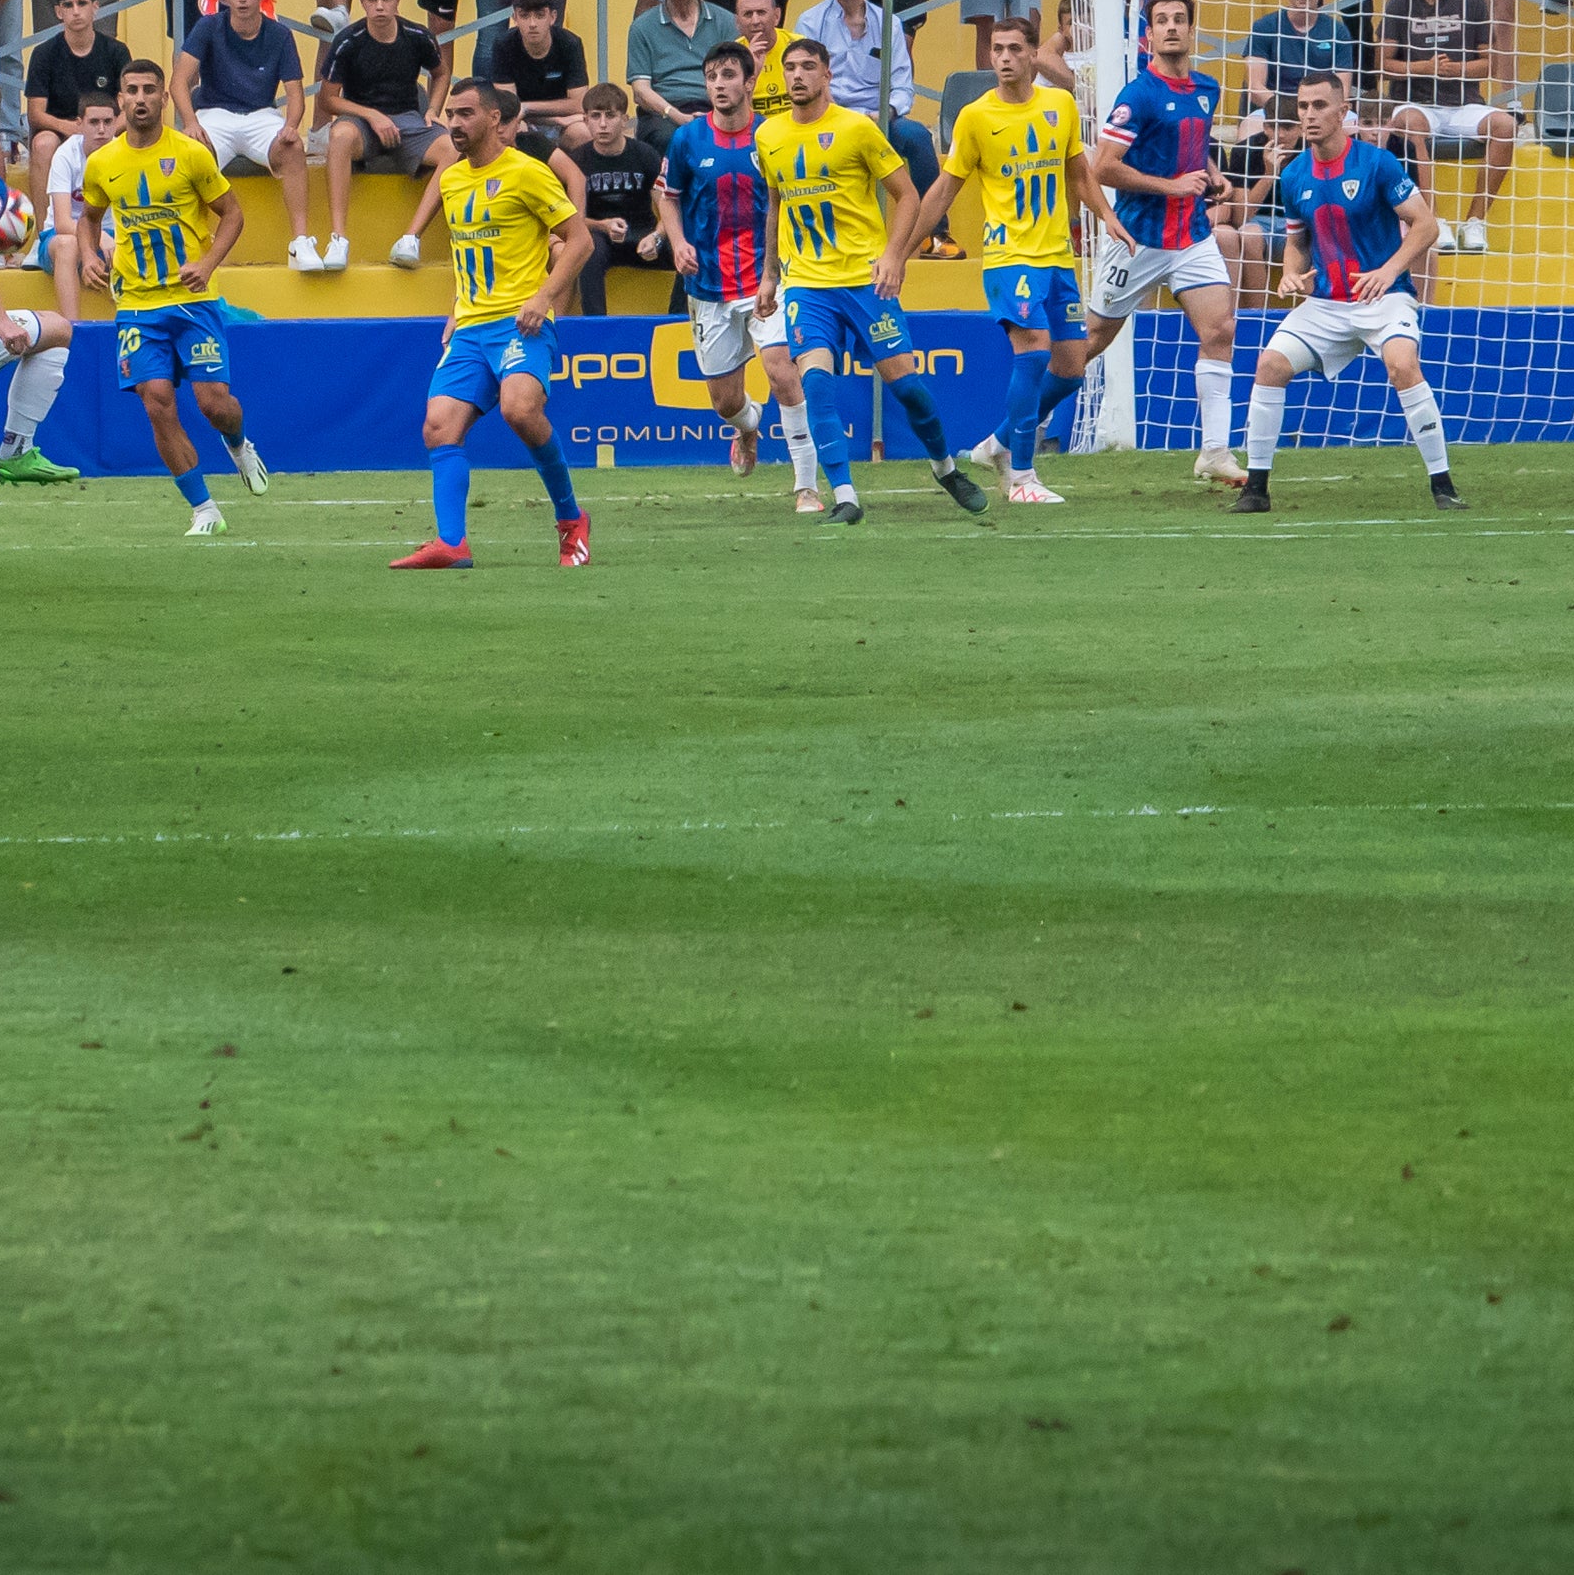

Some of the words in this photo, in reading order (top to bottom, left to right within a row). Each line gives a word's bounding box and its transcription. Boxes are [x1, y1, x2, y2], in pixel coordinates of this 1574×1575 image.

[1015, 275, 1031, 298] 4
[1107, 265, 1129, 288] 20
[786, 301, 799, 326] 9
[118, 327, 141, 356] 20
[191, 343, 221, 357] CRC
